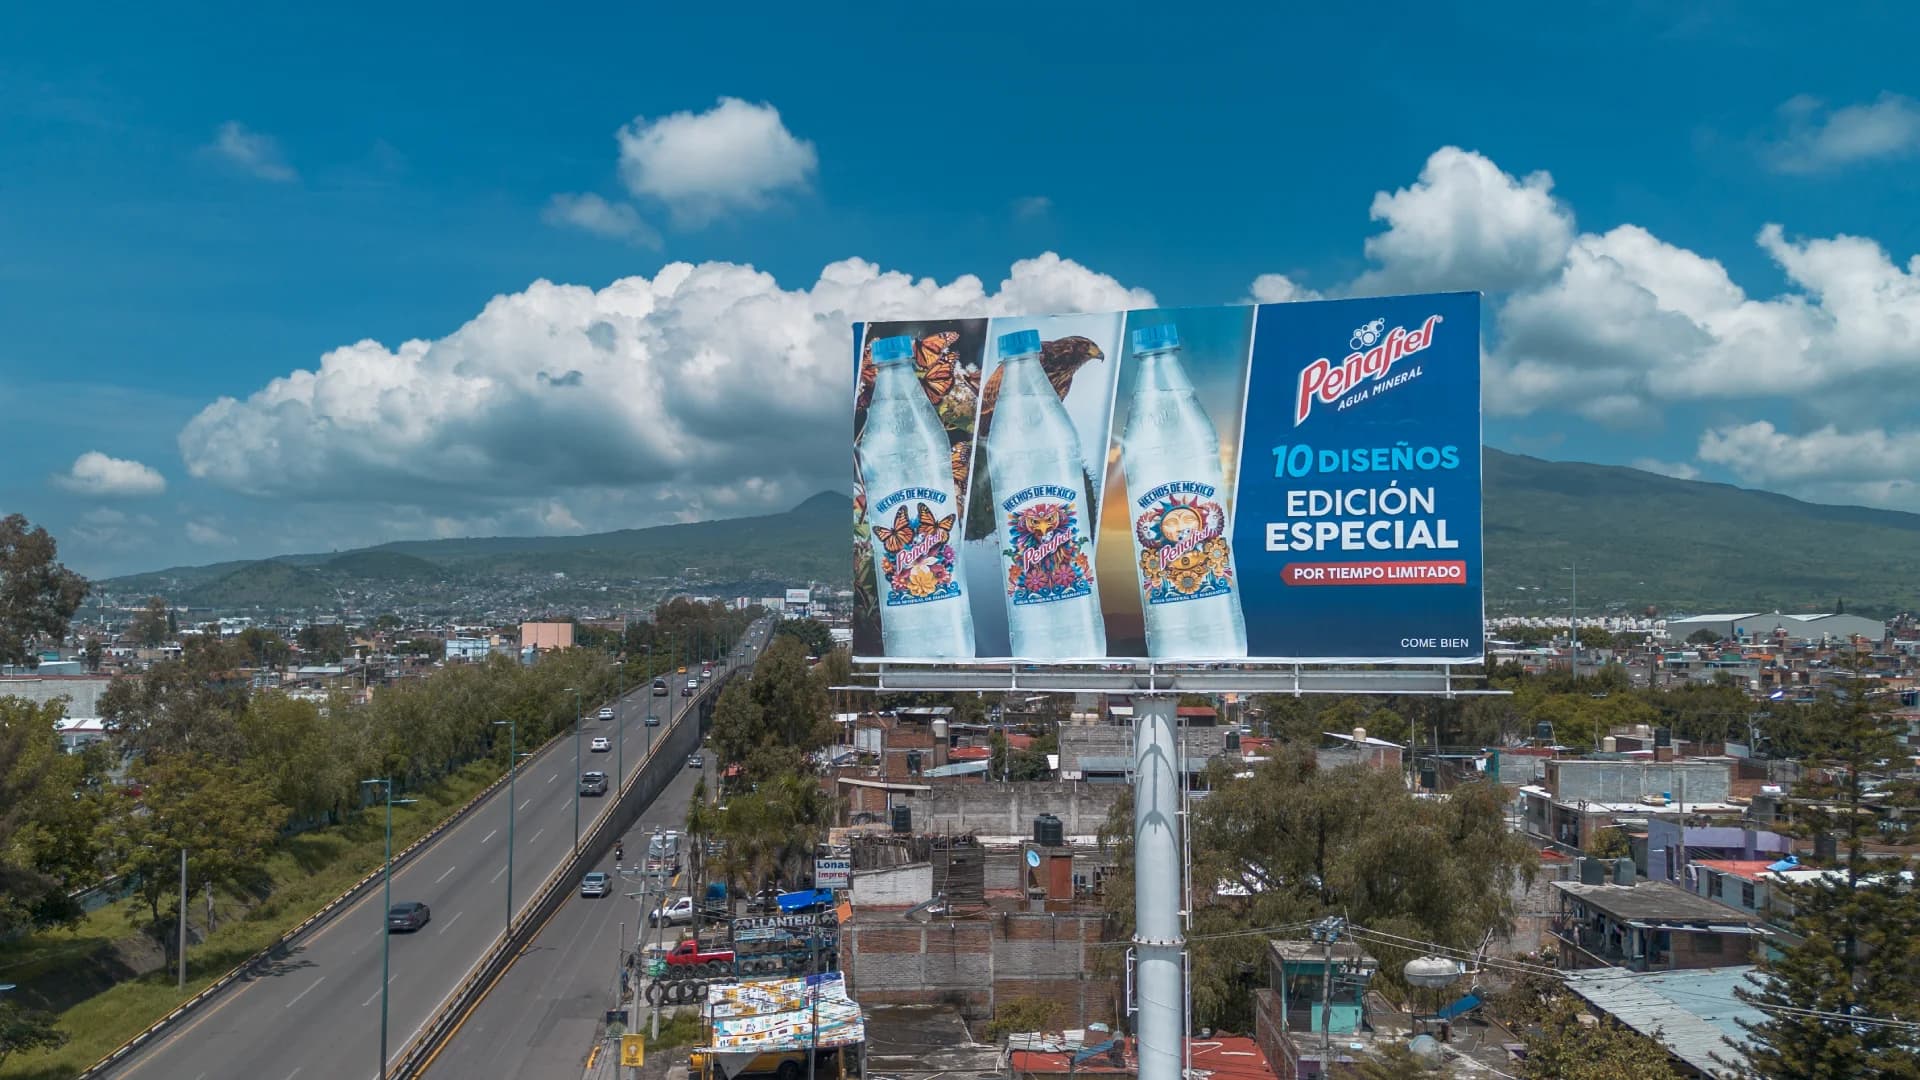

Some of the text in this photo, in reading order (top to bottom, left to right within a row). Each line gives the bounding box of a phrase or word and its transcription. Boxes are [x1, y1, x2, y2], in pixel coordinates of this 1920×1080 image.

[1295, 315, 1440, 427] Peñafiel
[1337, 366, 1423, 411] AGUA MINERAL
[1272, 441, 1460, 477] 10 DISEÑOS
[877, 491, 906, 511] HECHOS
[906, 489, 915, 499] DE
[1003, 488, 1033, 511] HECHOS
[1034, 486, 1044, 496] DE
[1138, 485, 1169, 508] HECHOS
[1170, 483, 1181, 492] DE
[1287, 480, 1435, 517] EDICIÓN
[1265, 519, 1459, 551] ESPECIAL
[1294, 566, 1461, 579] POR TIEMPO LIMITADO
[1401, 638, 1469, 648] COME BIEN
[817, 860, 850, 869] Lonas
